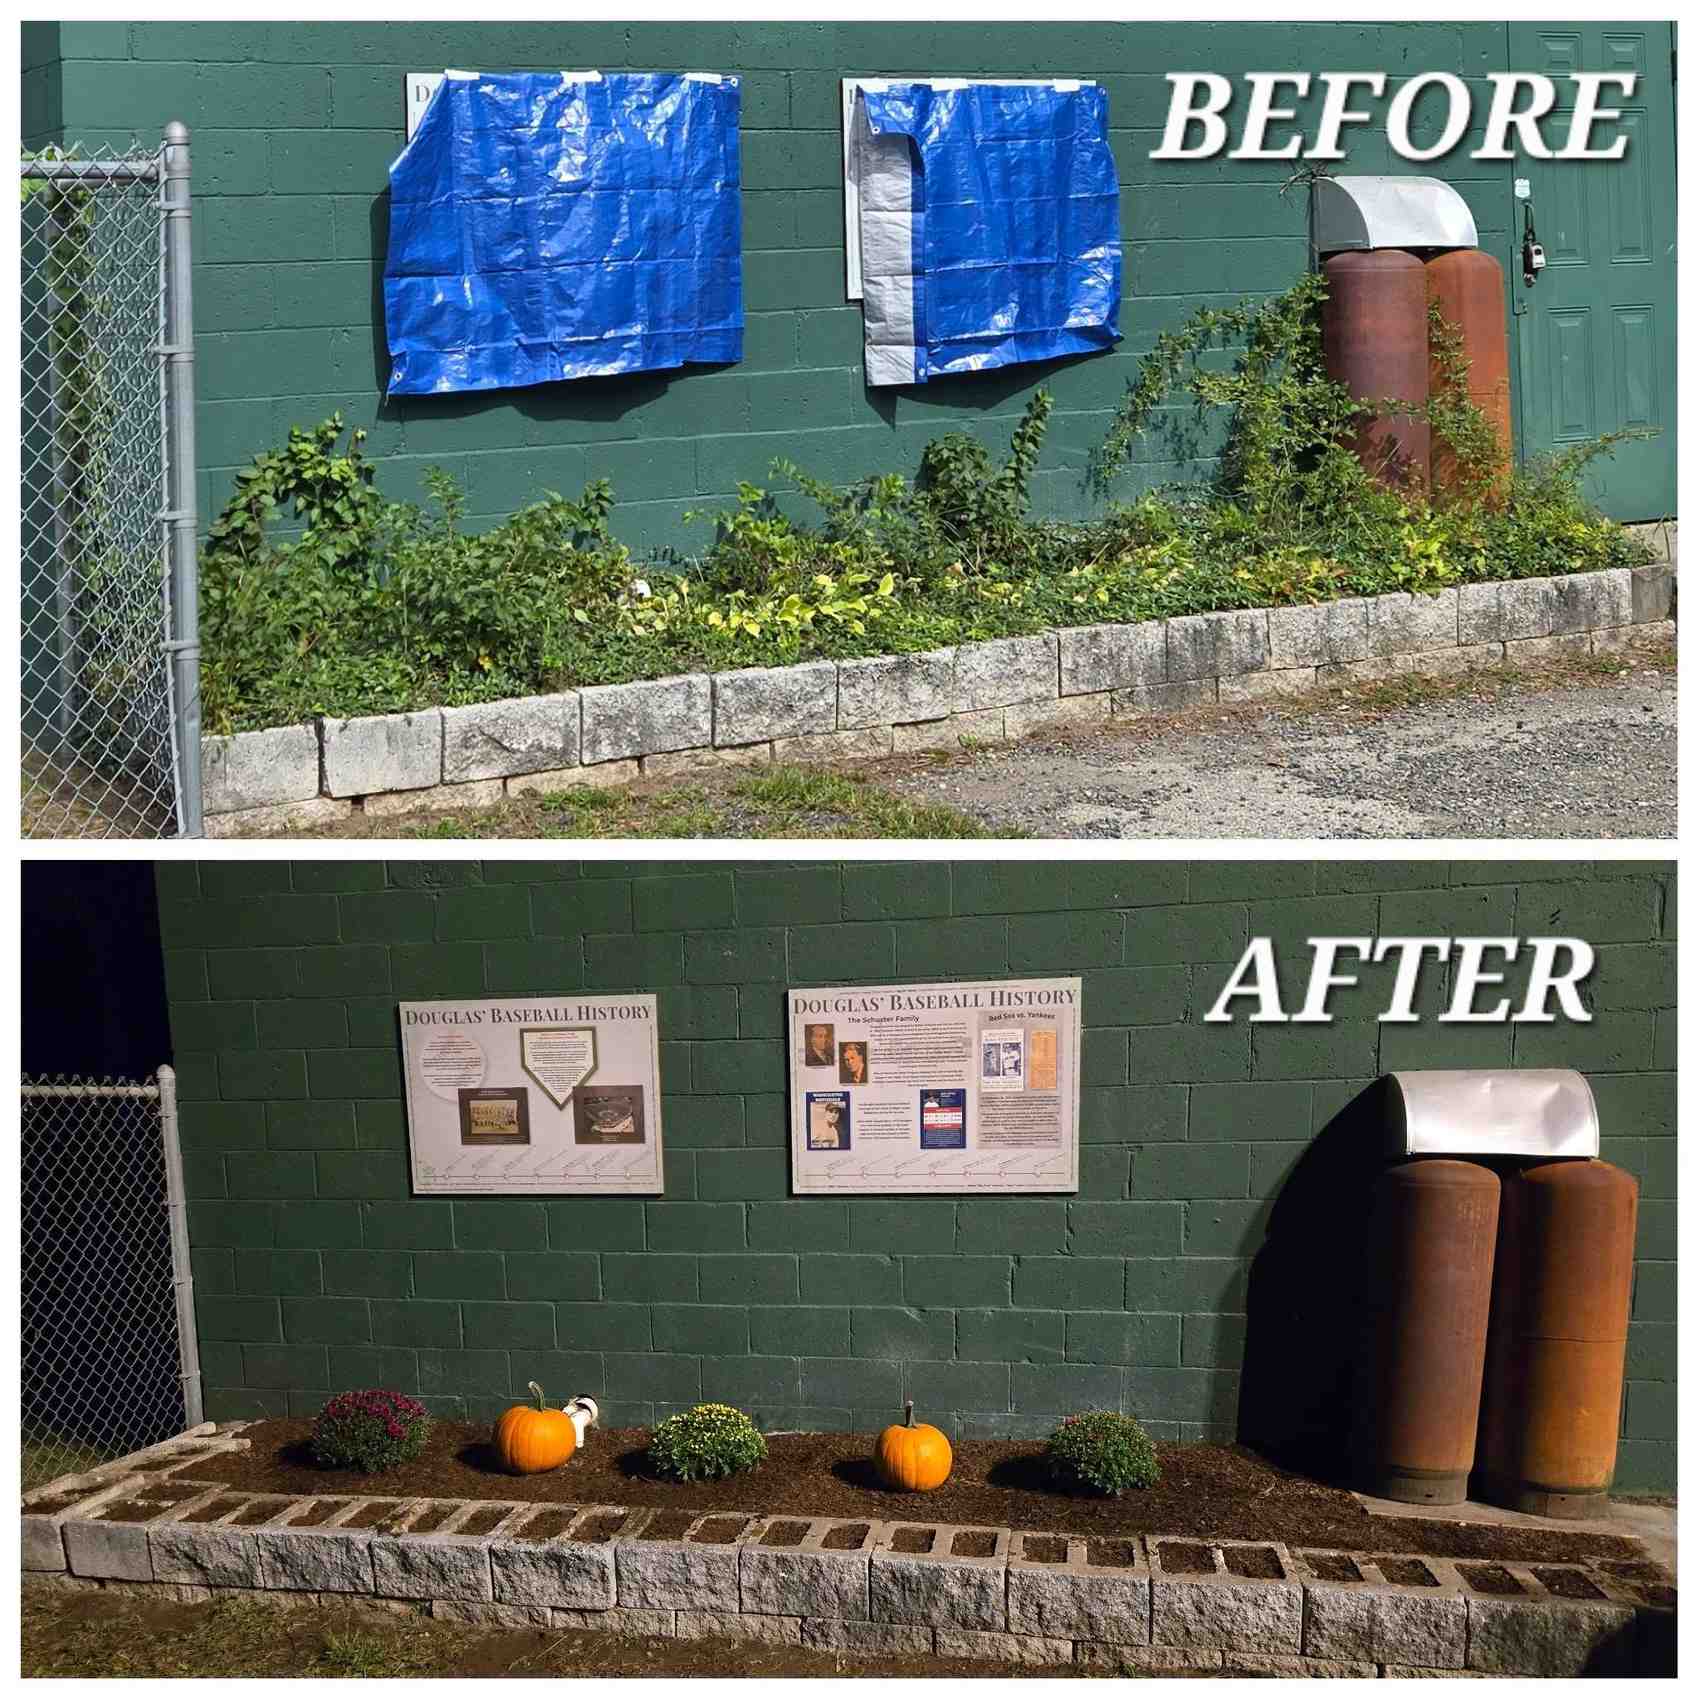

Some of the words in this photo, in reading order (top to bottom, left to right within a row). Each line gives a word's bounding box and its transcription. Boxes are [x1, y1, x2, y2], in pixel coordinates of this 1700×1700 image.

[794, 997, 885, 1015] DOUGLAS'
[890, 993, 985, 1011] BASEBALL
[990, 989, 1077, 1007] HISTORY
[405, 1009, 486, 1025] DOUGLAS'
[491, 1006, 573, 1024] BASEBALL
[577, 1005, 650, 1021] HISTORY
[848, 1016, 861, 1024] The
[895, 1014, 920, 1023] Family
[988, 1014, 1002, 1022] Red
[1002, 1012, 1016, 1020] Sox
[1027, 1011, 1056, 1020] Yankees
